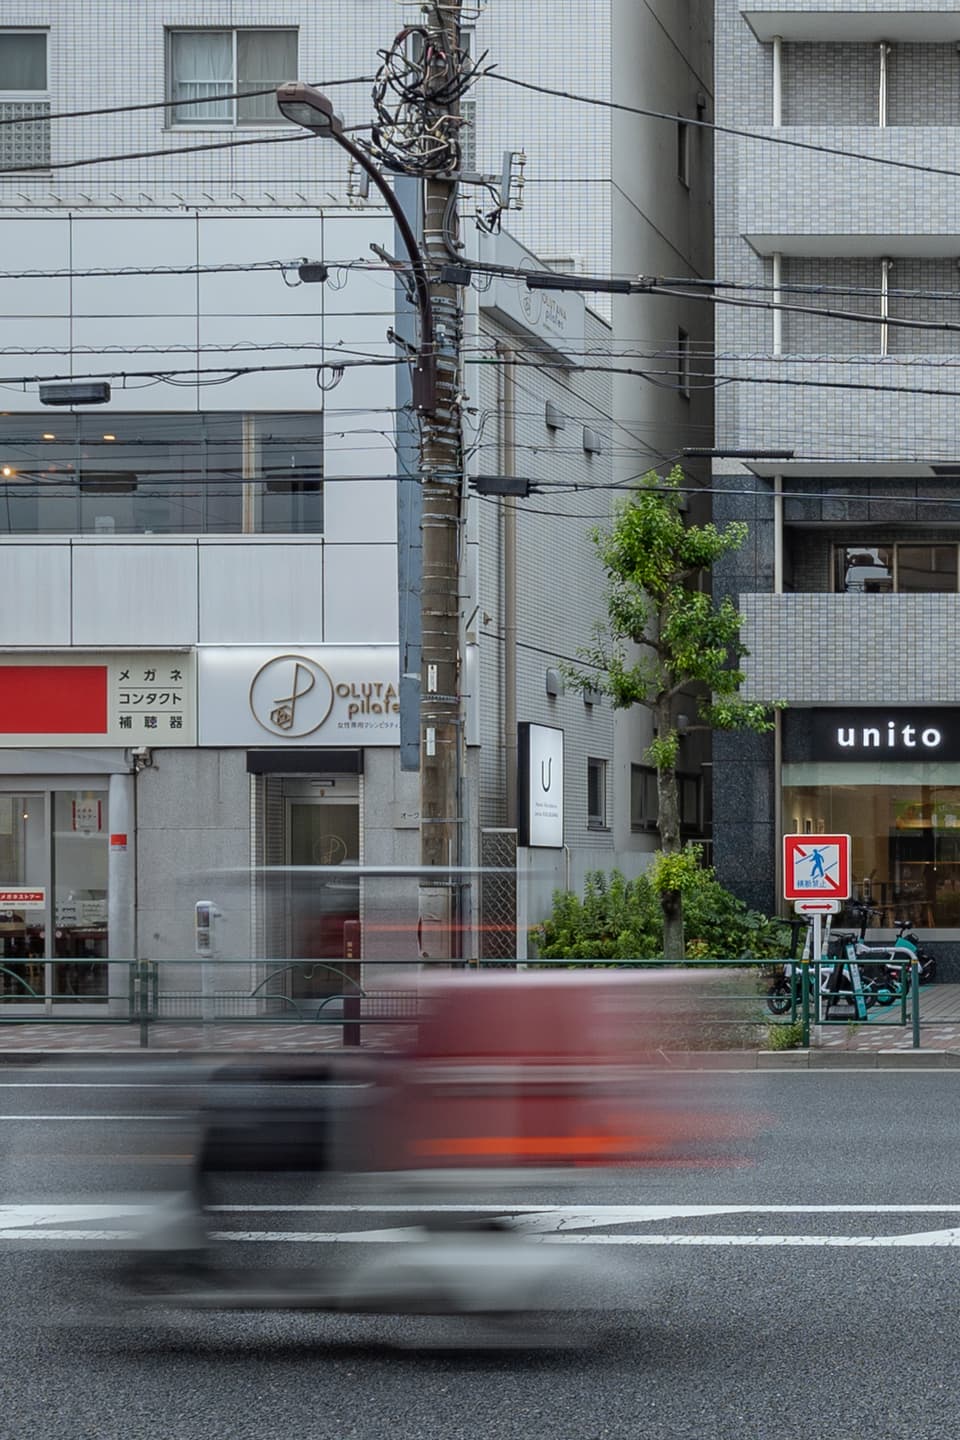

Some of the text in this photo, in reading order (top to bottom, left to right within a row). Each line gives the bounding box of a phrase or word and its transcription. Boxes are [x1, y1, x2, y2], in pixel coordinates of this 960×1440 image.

[118, 669, 183, 681] メガネ
[335, 683, 400, 698] OLUTA
[119, 692, 182, 705] コンタクト
[119, 716, 183, 729] 補聴器
[838, 721, 941, 747] unito
